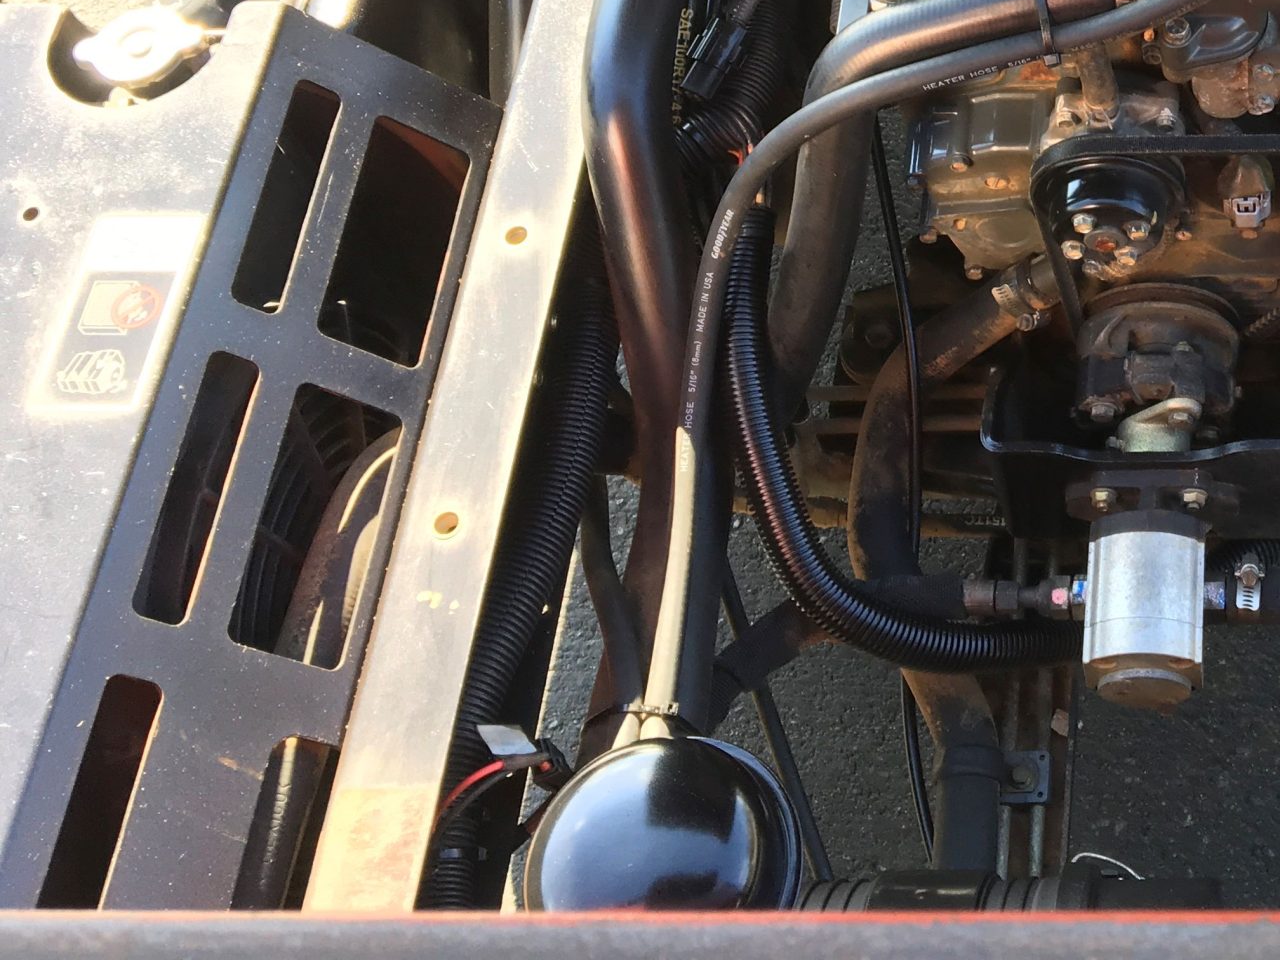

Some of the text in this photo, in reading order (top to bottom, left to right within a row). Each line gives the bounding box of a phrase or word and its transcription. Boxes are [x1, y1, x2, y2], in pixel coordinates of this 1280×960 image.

[922, 74, 966, 91] HEATER
[969, 65, 999, 78] HOSE
[710, 208, 735, 260] GOODYEAR
[703, 271, 715, 290] USA
[701, 293, 709, 303] IN
[695, 305, 707, 333] MADE
[691, 340, 702, 366] (8mm)
[684, 401, 695, 429] HOSE
[679, 433, 691, 472] HEATER
